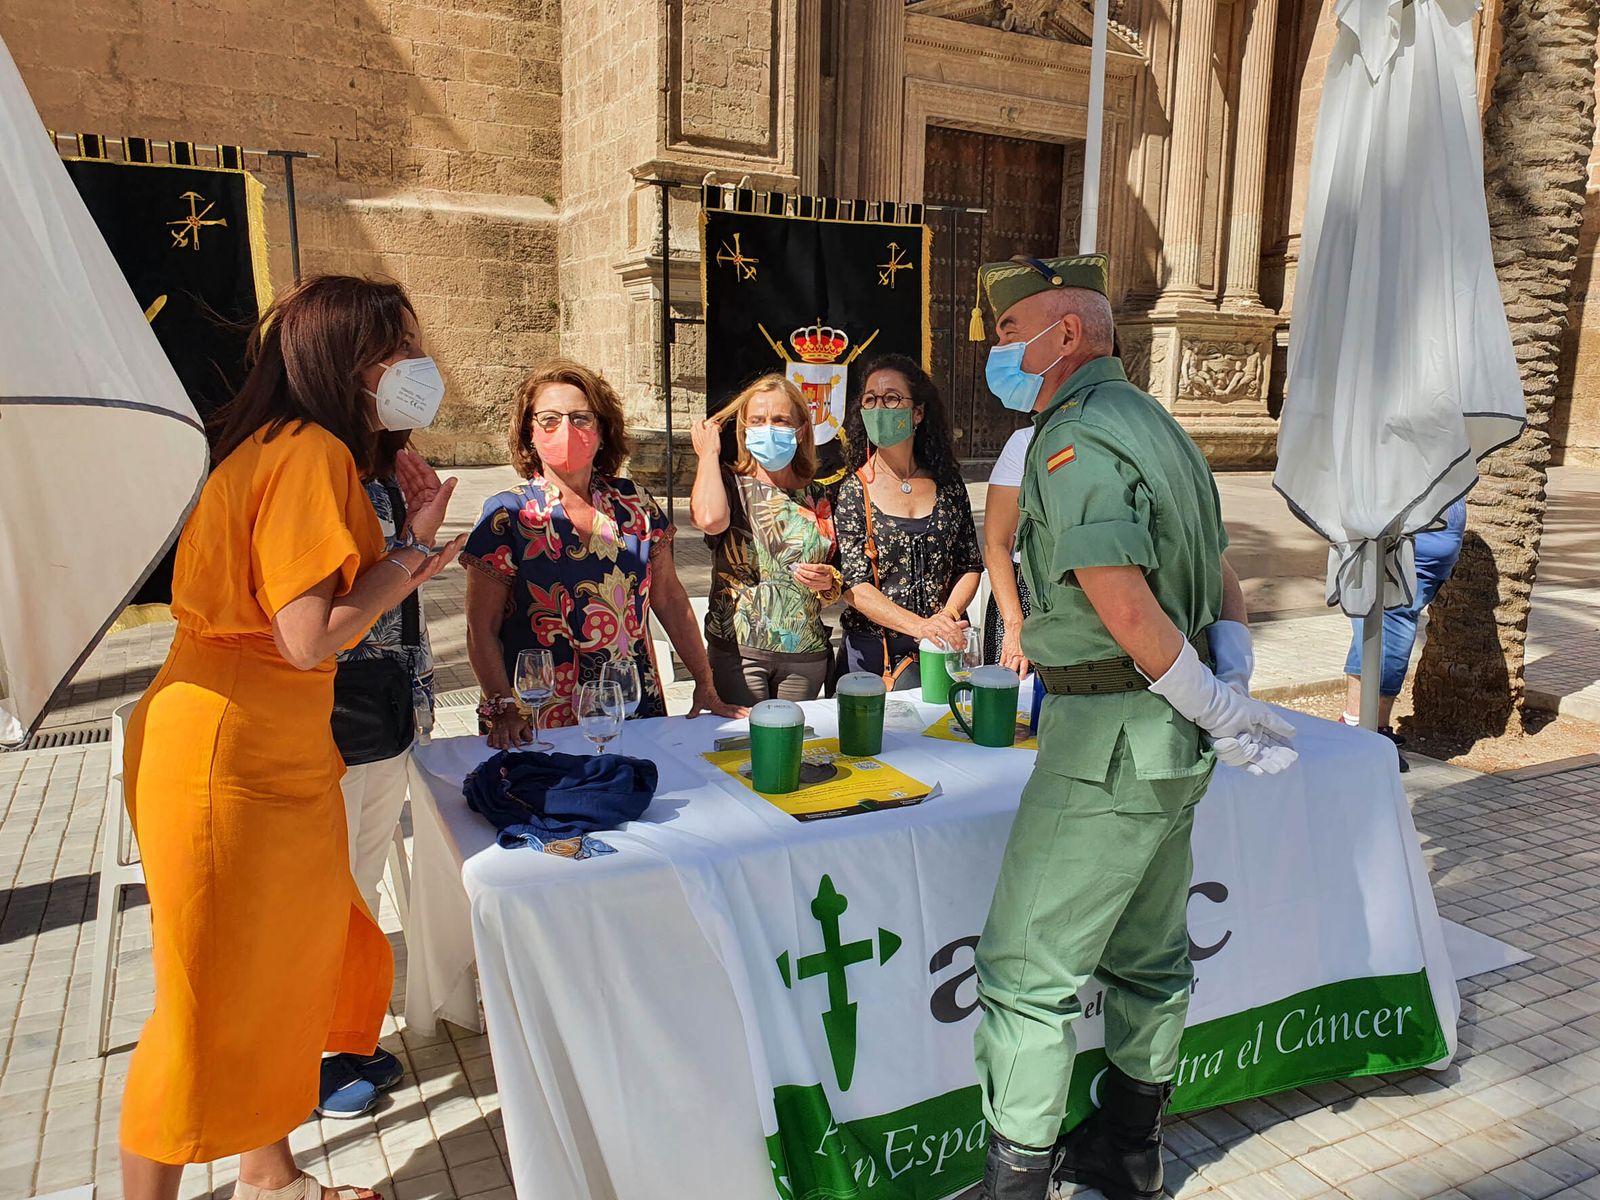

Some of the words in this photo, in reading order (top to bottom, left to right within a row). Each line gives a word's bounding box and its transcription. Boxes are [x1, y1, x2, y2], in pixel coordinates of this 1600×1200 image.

[1084, 991, 1103, 1019] el
[882, 1118, 987, 1179] Espa
[1237, 1020, 1264, 1070] el
[1275, 1004, 1412, 1055] Cáncer
